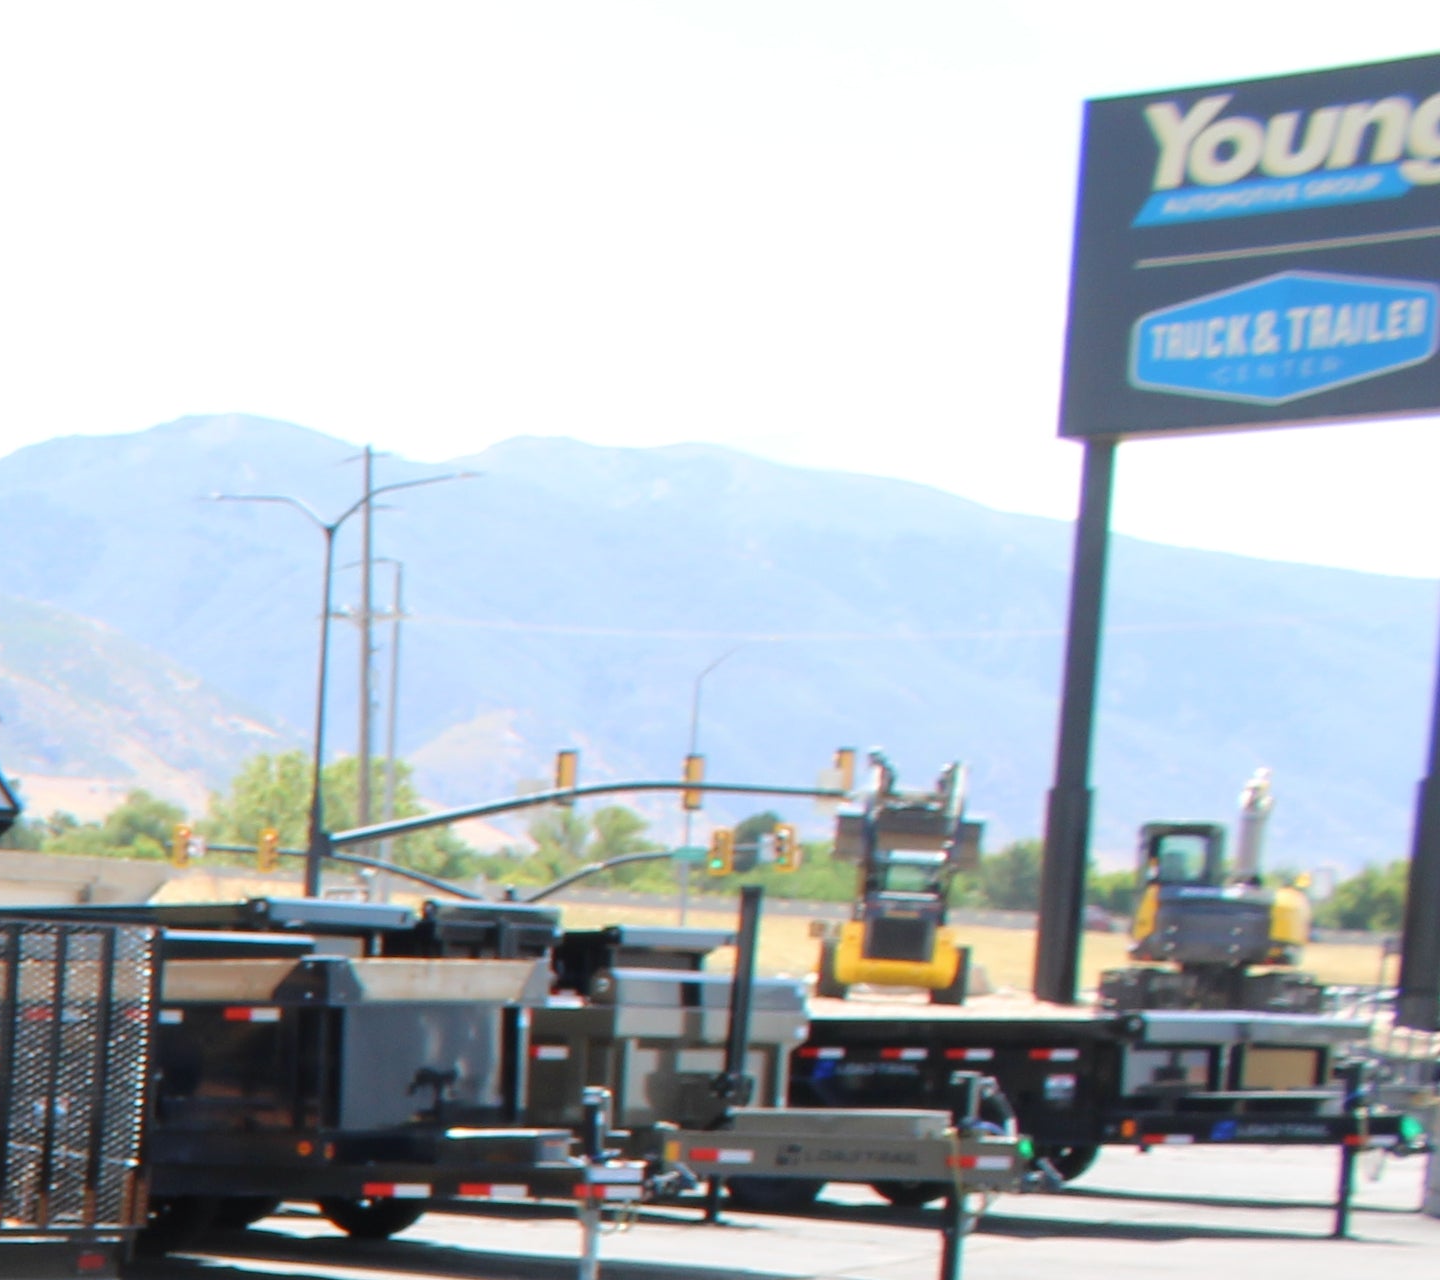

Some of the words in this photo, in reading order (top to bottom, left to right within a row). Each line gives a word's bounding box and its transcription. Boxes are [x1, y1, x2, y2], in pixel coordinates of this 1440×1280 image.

[1303, 172, 1384, 200] GROUP
[1151, 314, 1252, 361] TRUCK
[1252, 310, 1280, 356] &
[1286, 298, 1428, 353] TRAILER
[1211, 355, 1343, 385] CENTER
